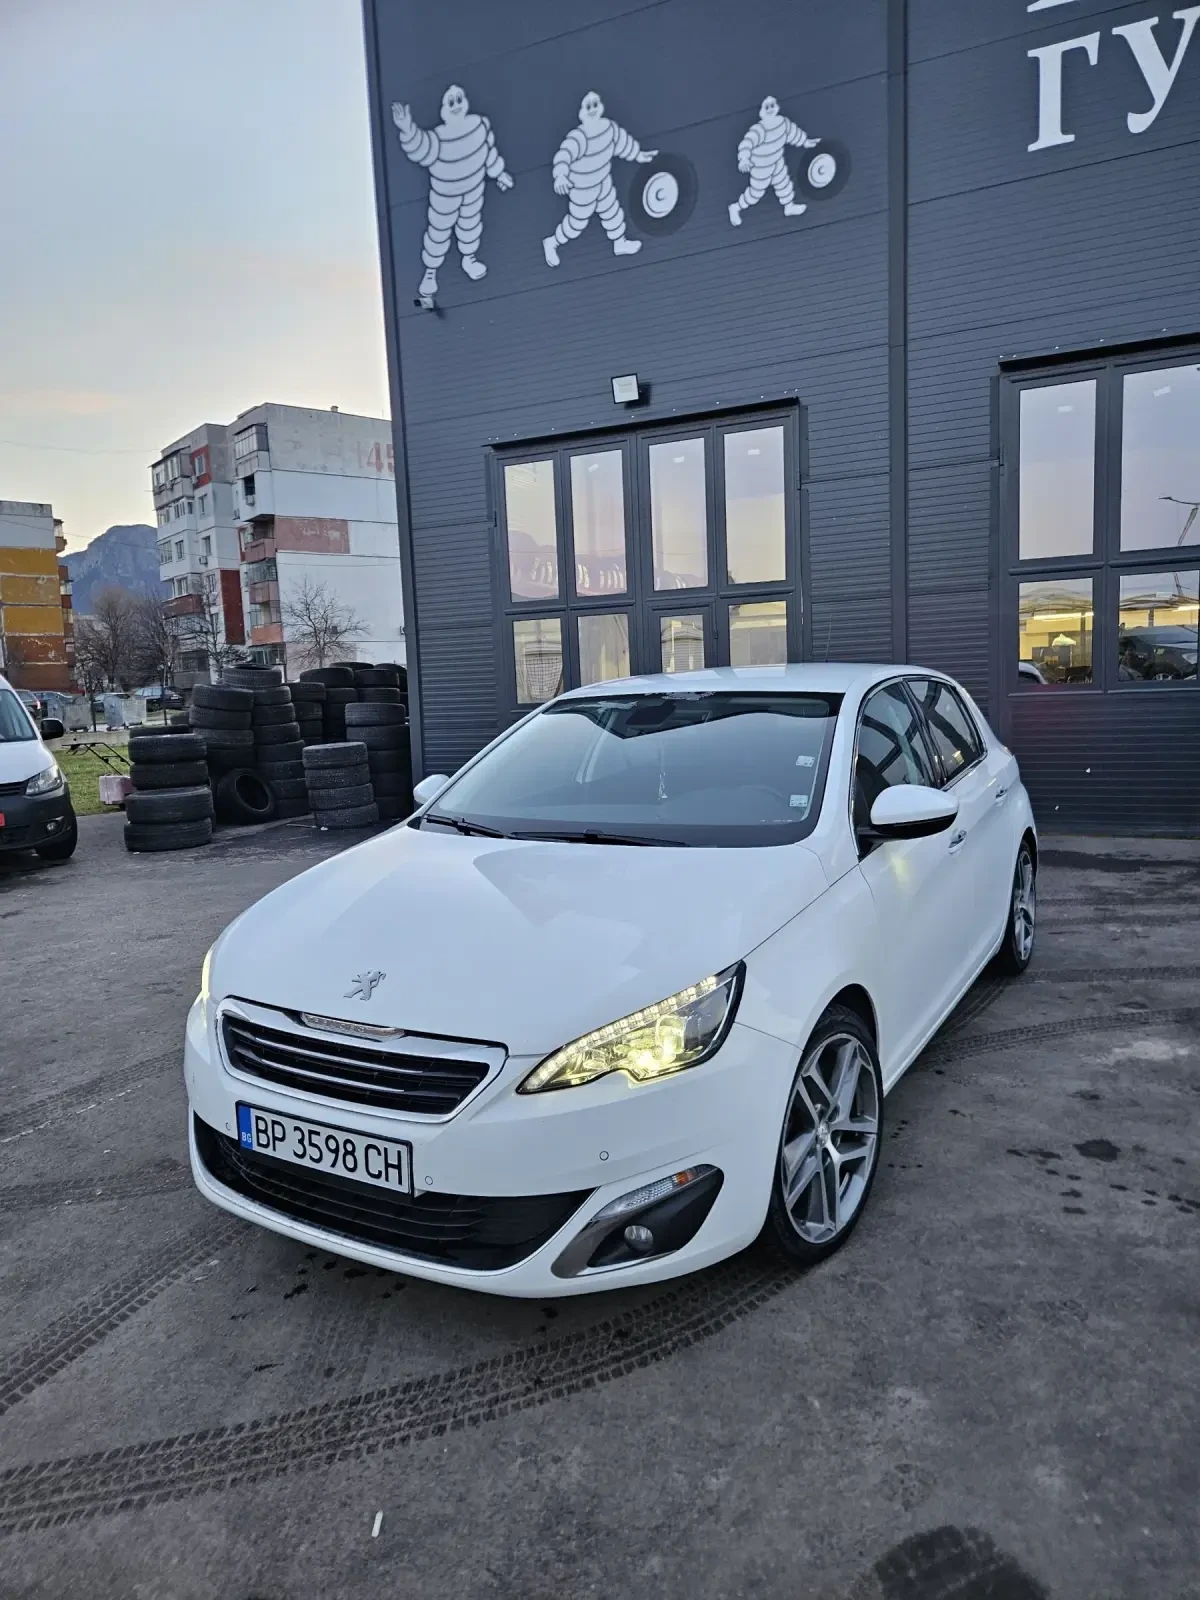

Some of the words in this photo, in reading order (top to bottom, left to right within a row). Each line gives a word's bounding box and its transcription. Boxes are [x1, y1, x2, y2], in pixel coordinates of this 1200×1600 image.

[241, 1131, 252, 1143] BG
[255, 1115, 286, 1152] BP
[292, 1125, 358, 1173] 3598
[364, 1143, 403, 1186] CH
